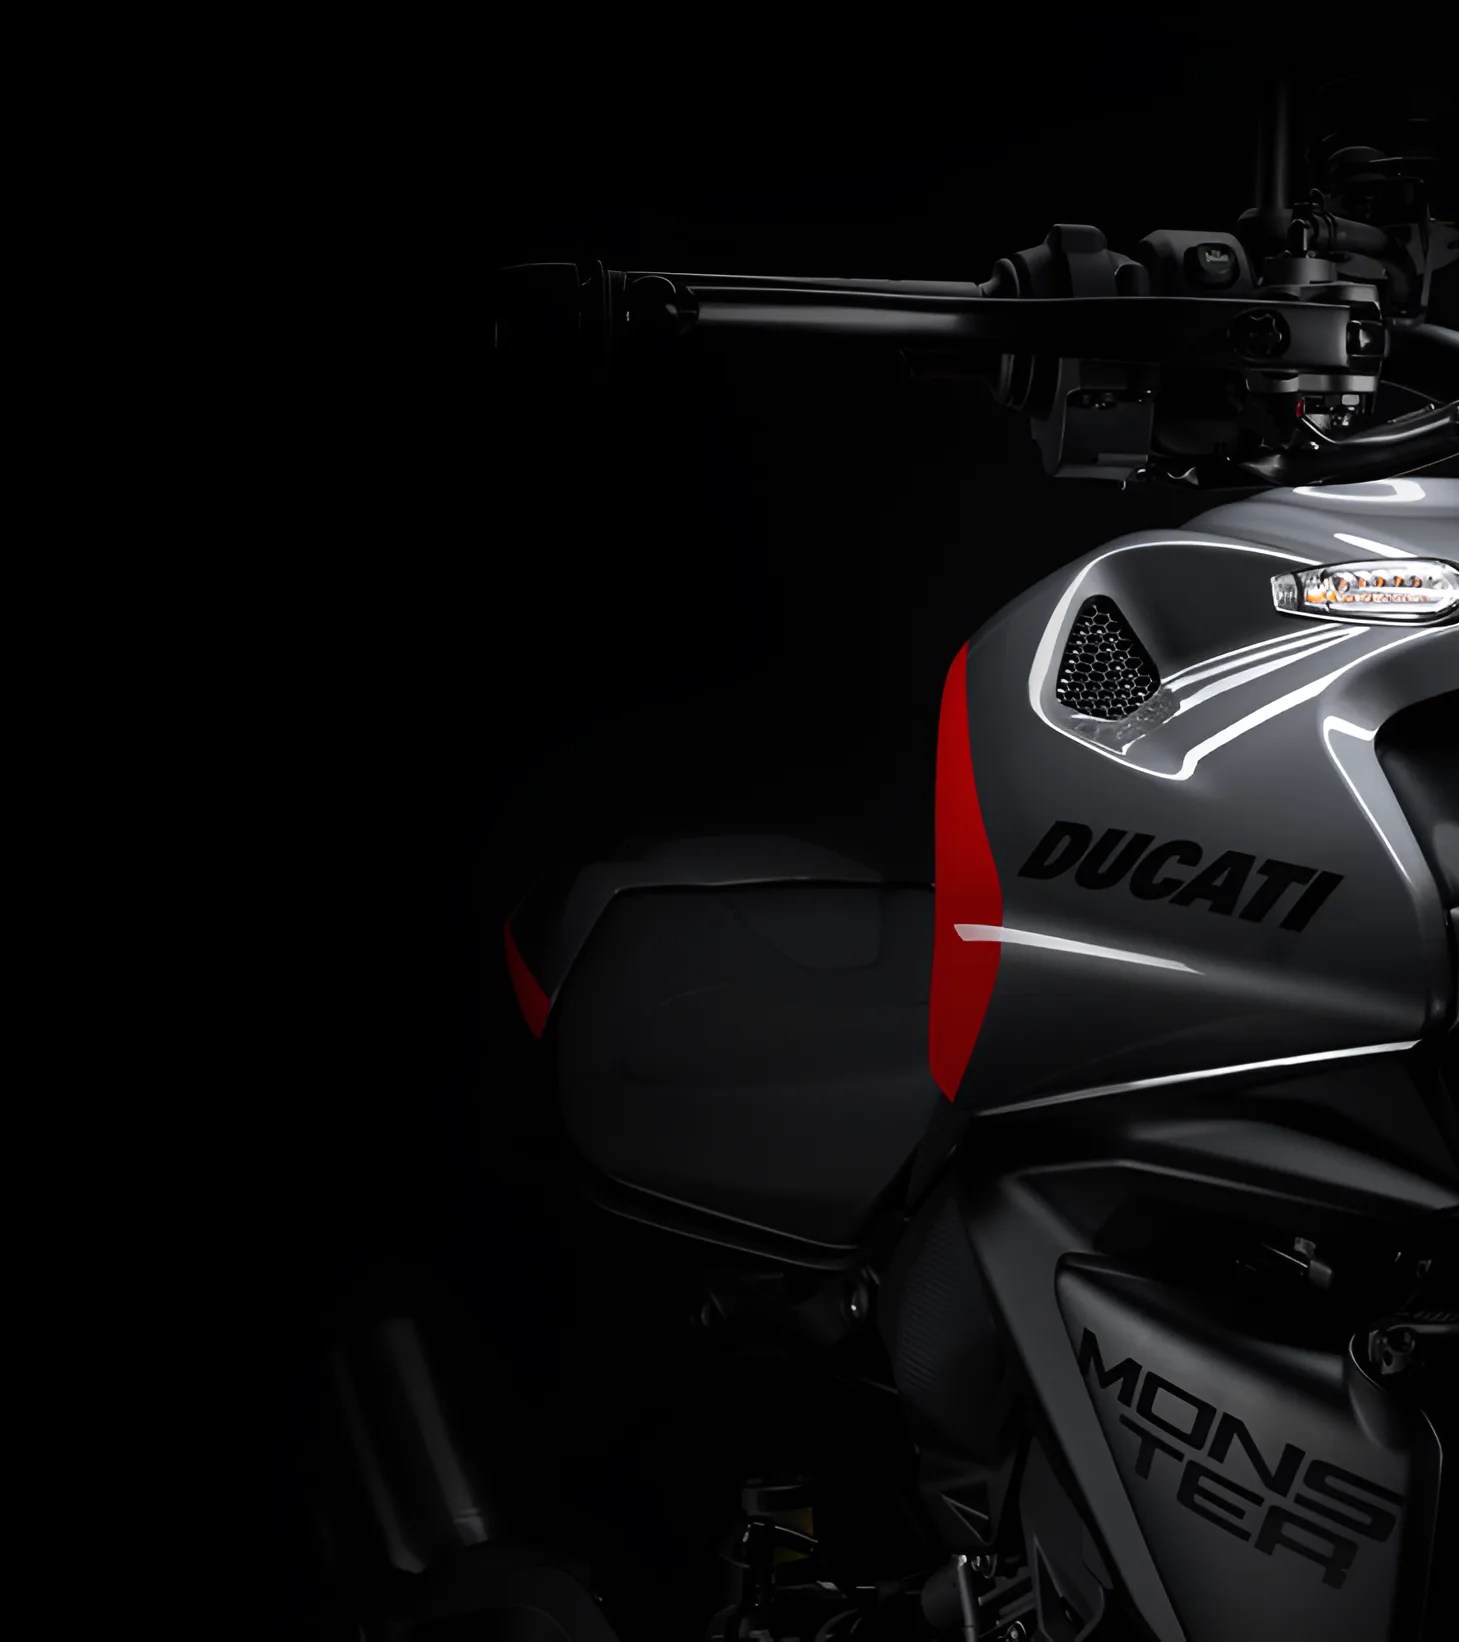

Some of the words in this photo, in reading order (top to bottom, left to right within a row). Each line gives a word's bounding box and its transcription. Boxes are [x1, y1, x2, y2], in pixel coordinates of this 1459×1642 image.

[1017, 820, 1345, 933] DUCATI
[1080, 1327, 1405, 1543] MONS
[1118, 1412, 1359, 1590] TER
